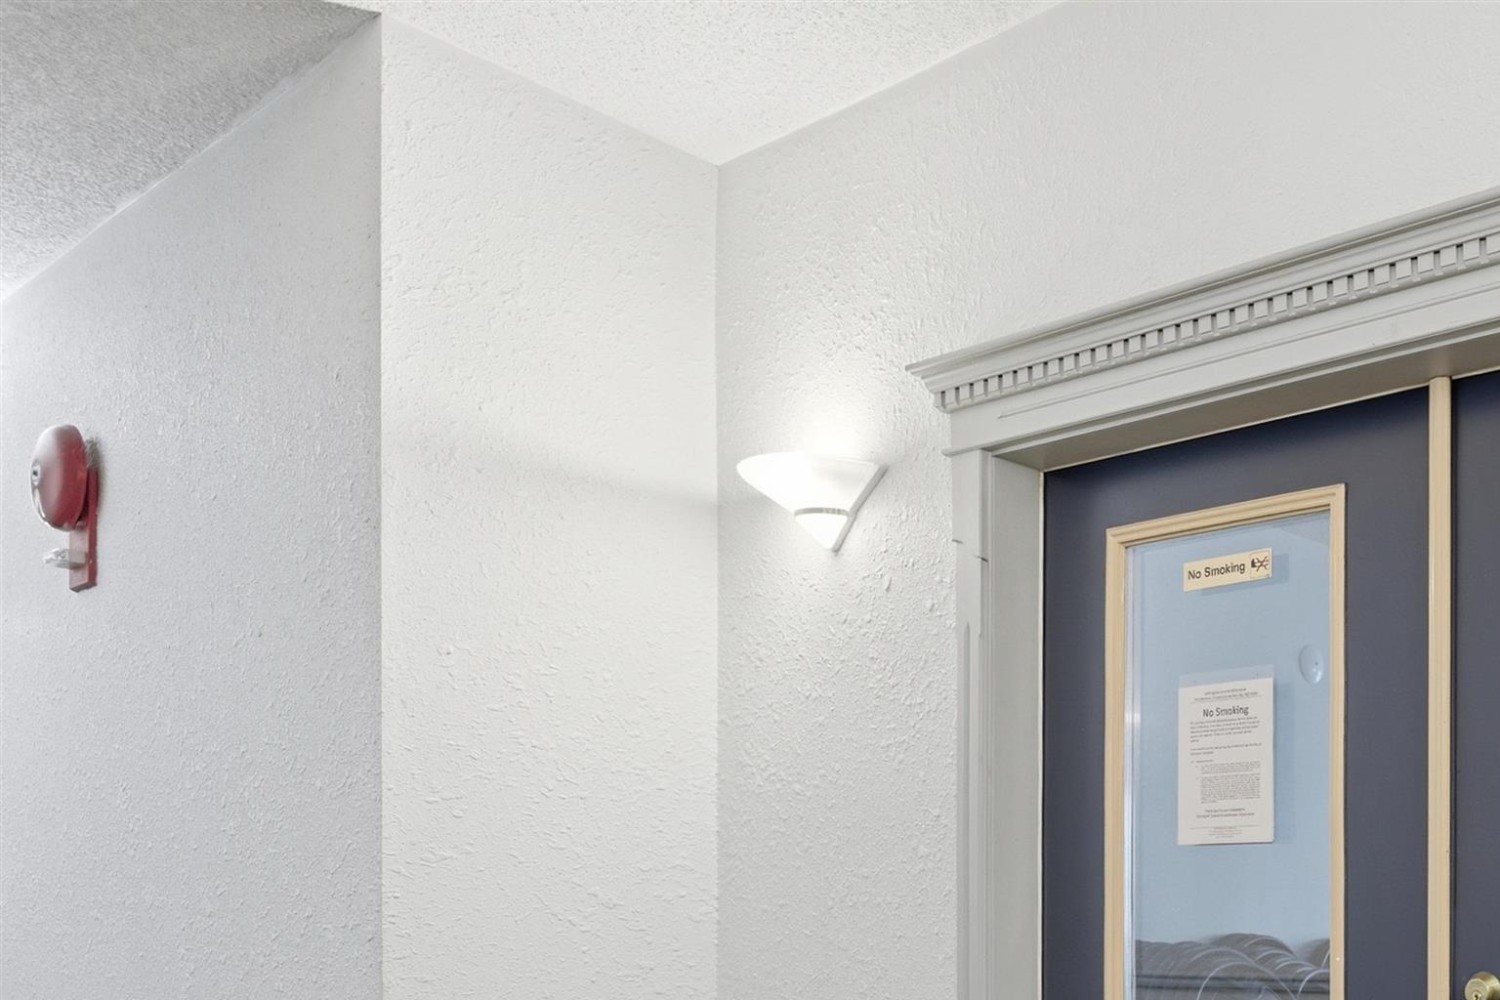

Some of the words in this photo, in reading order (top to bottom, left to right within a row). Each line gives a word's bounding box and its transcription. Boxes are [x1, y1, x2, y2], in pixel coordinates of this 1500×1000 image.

[1187, 569, 1202, 580] No
[1204, 562, 1246, 578] Smoking
[1202, 708, 1214, 717] No
[1215, 705, 1249, 717] Smoking
